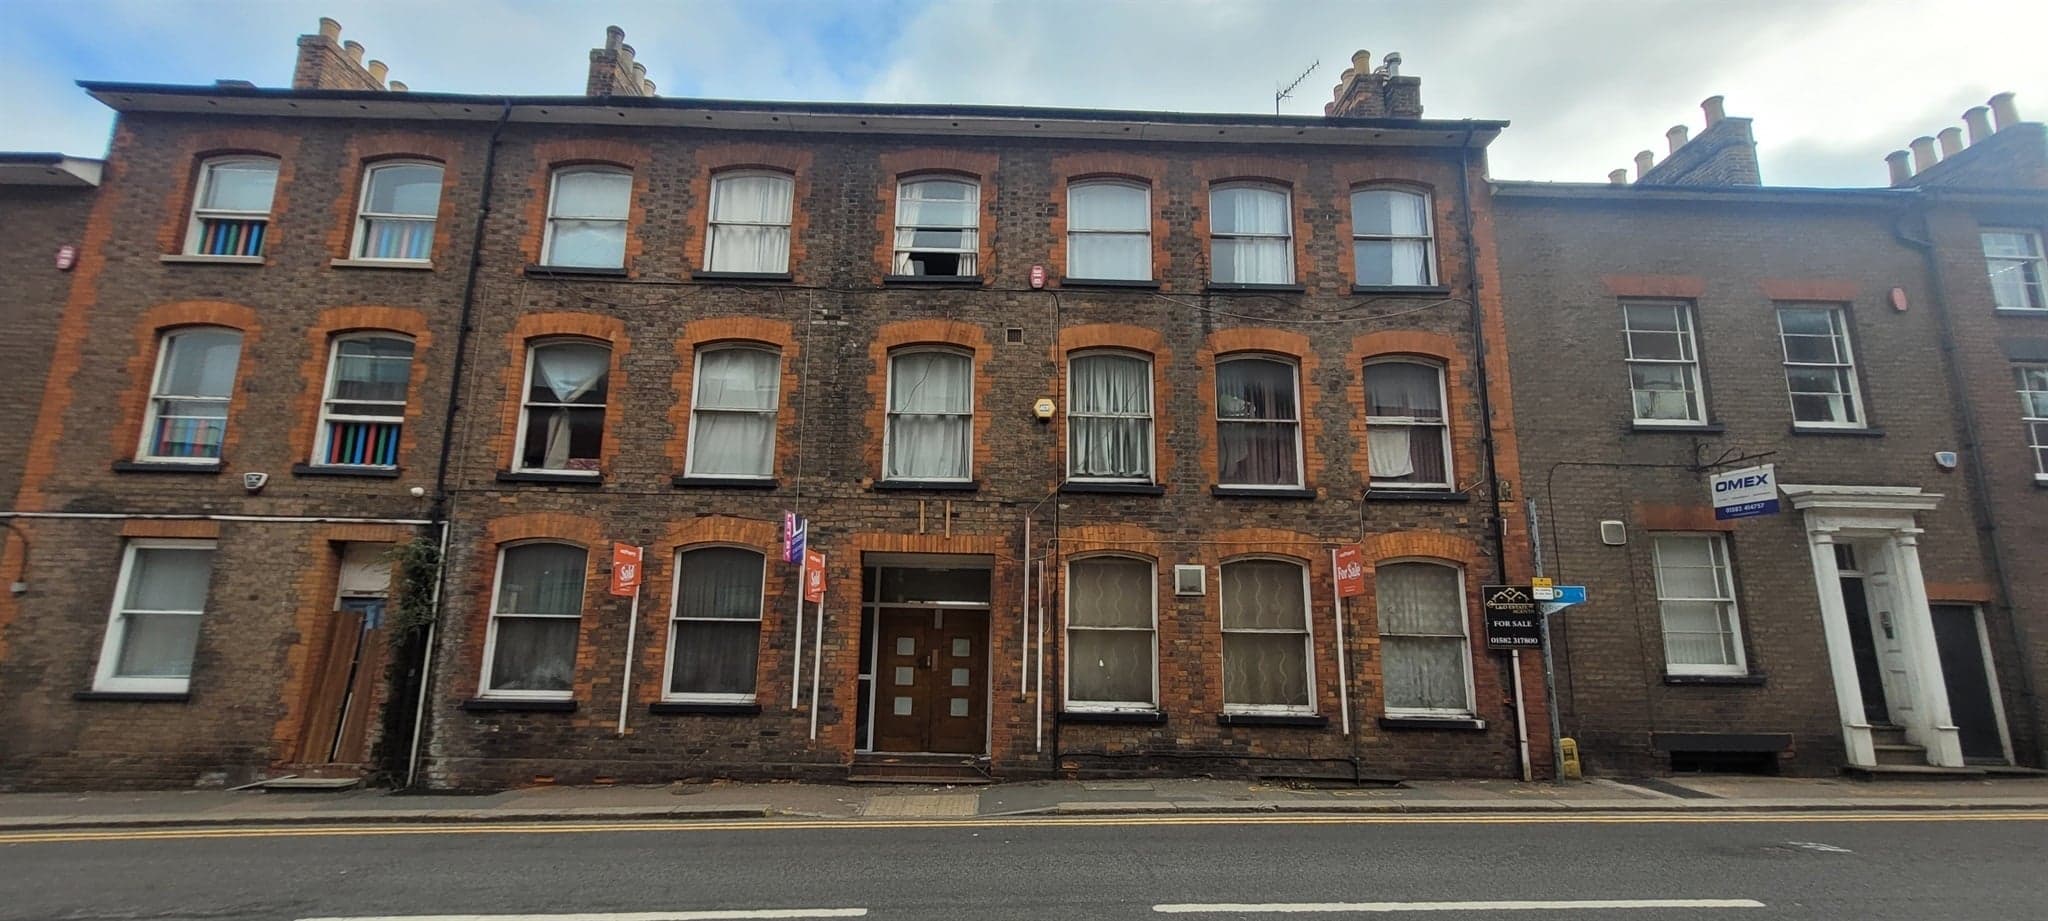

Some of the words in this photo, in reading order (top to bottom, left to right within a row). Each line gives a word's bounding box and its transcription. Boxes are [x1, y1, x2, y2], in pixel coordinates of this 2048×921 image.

[1716, 474, 1768, 492] OMEX
[620, 564, 635, 580] Sold
[1337, 567, 1347, 580] For
[1347, 561, 1361, 578] Sale
